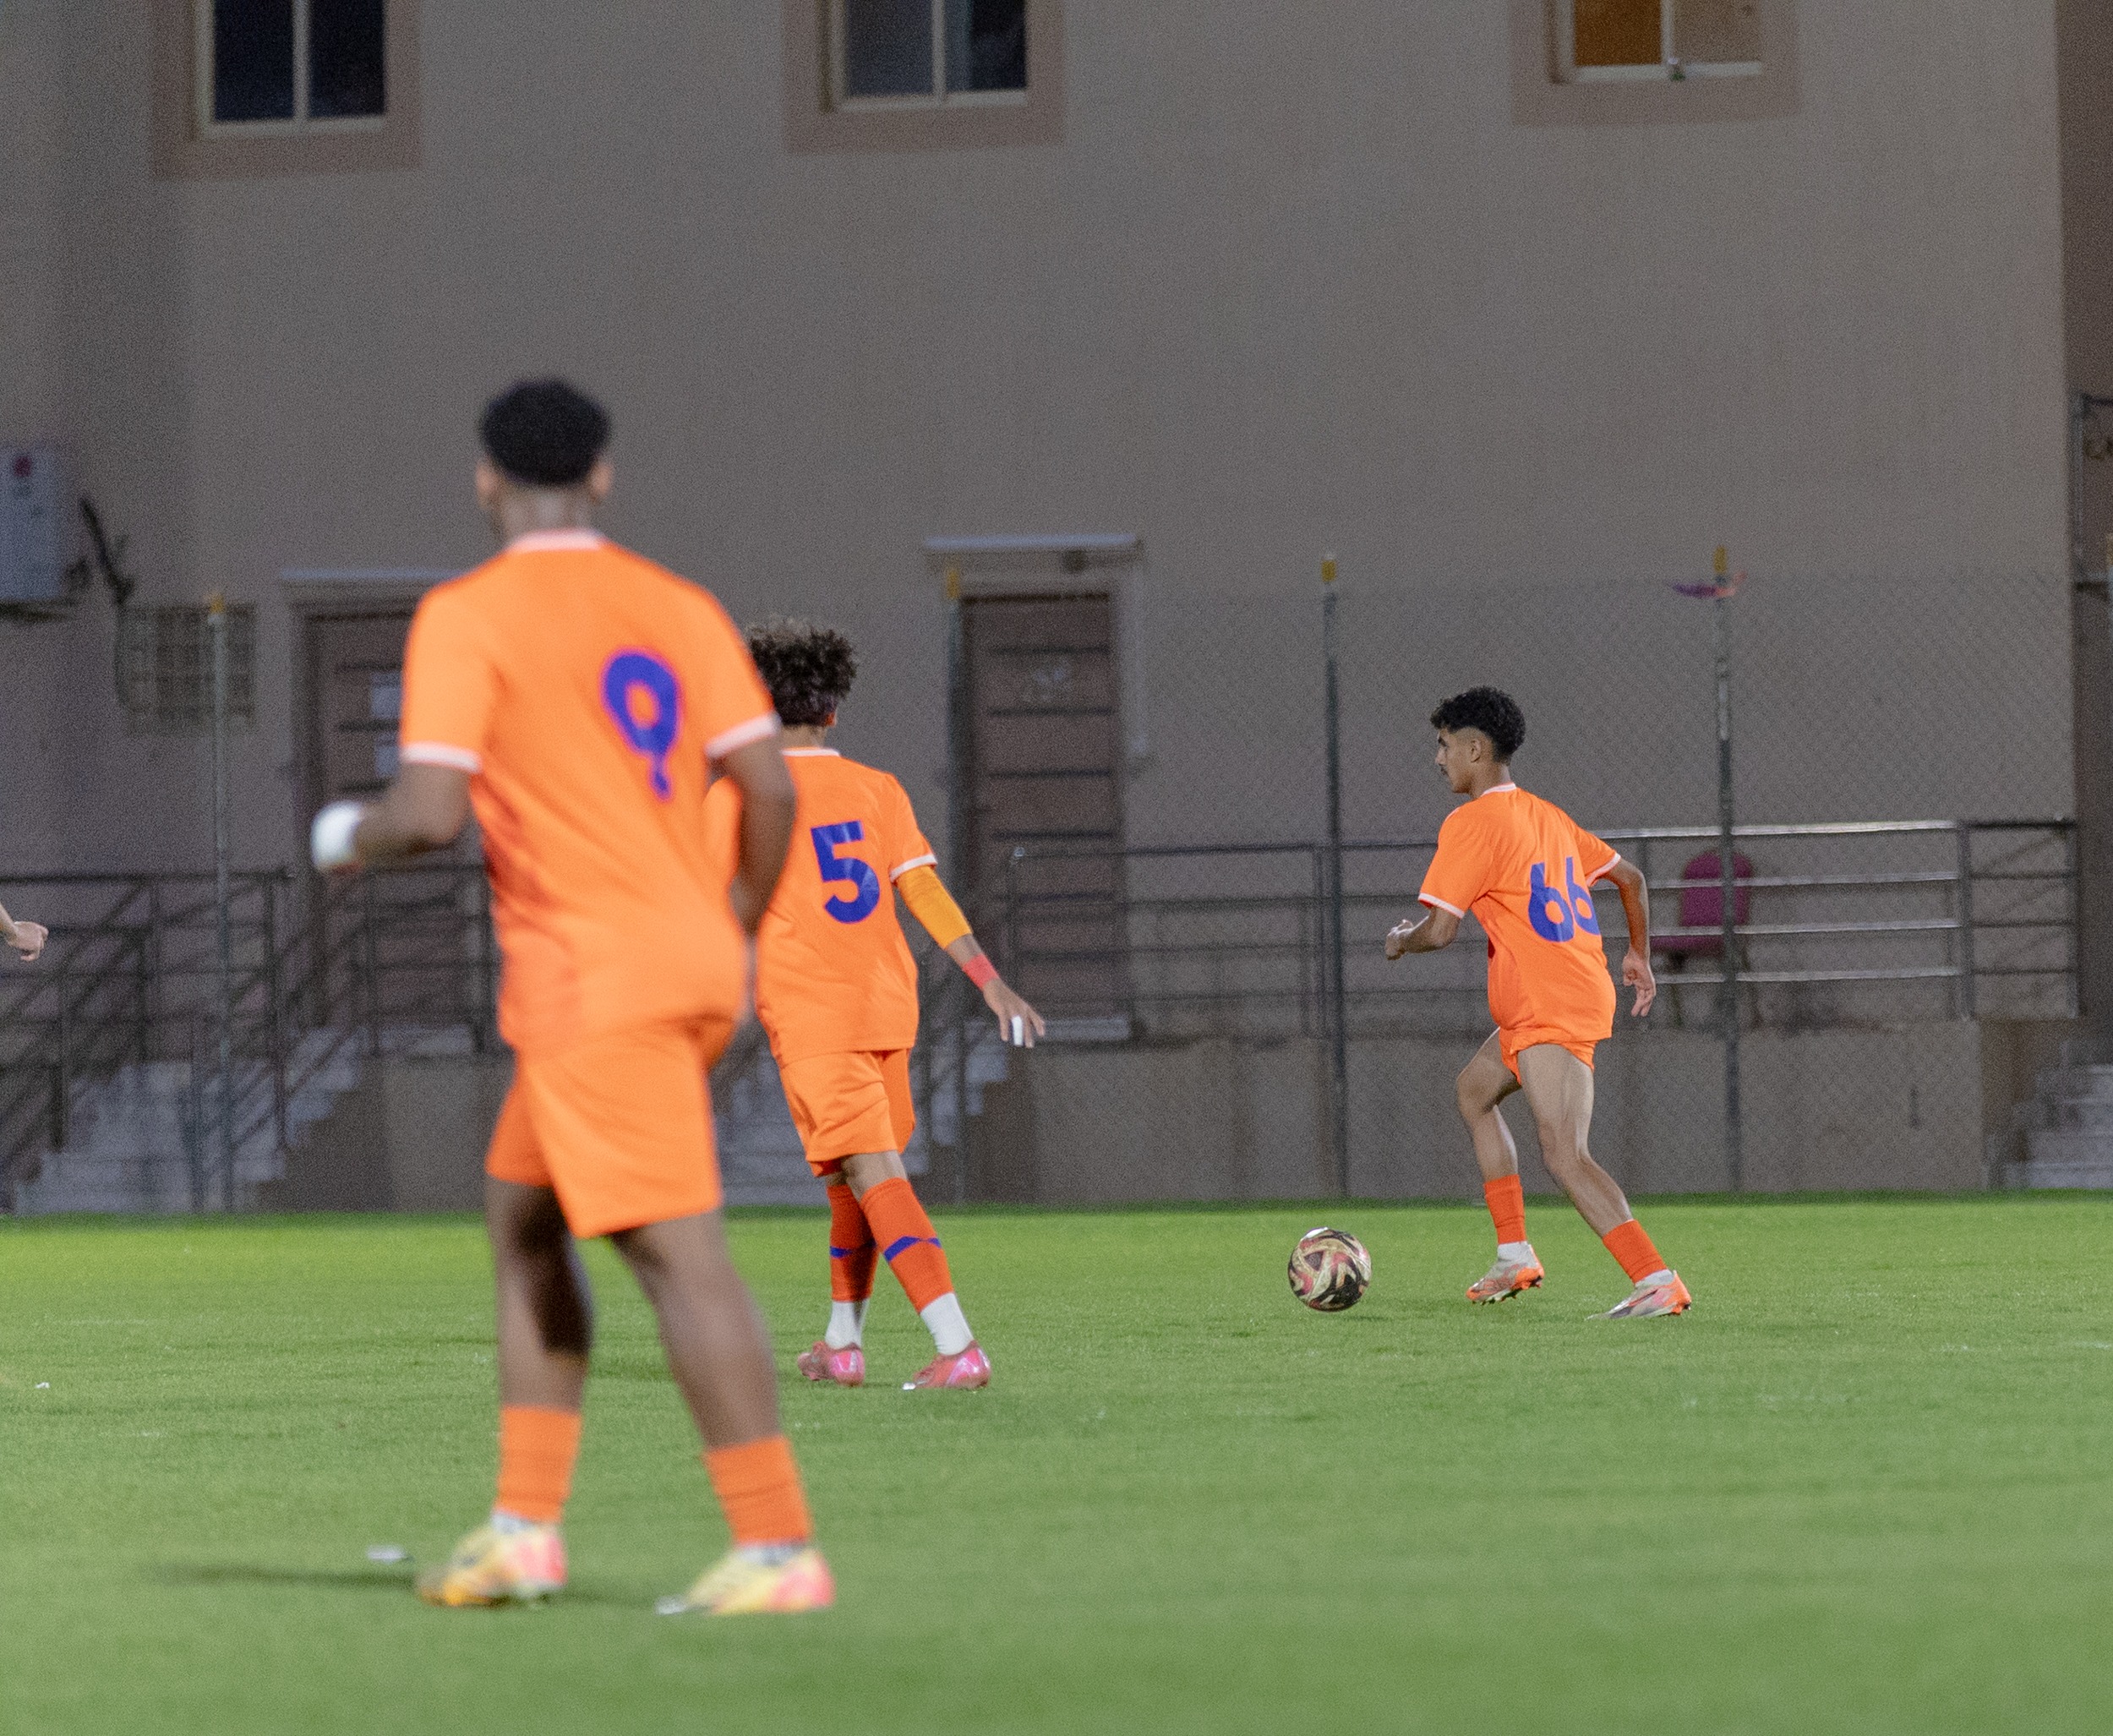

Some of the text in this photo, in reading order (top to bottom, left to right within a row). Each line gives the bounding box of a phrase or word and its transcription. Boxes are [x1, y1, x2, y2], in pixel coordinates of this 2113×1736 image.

[599, 648, 684, 801] 9
[811, 820, 880, 924] 5
[1528, 856, 1601, 942] 66
